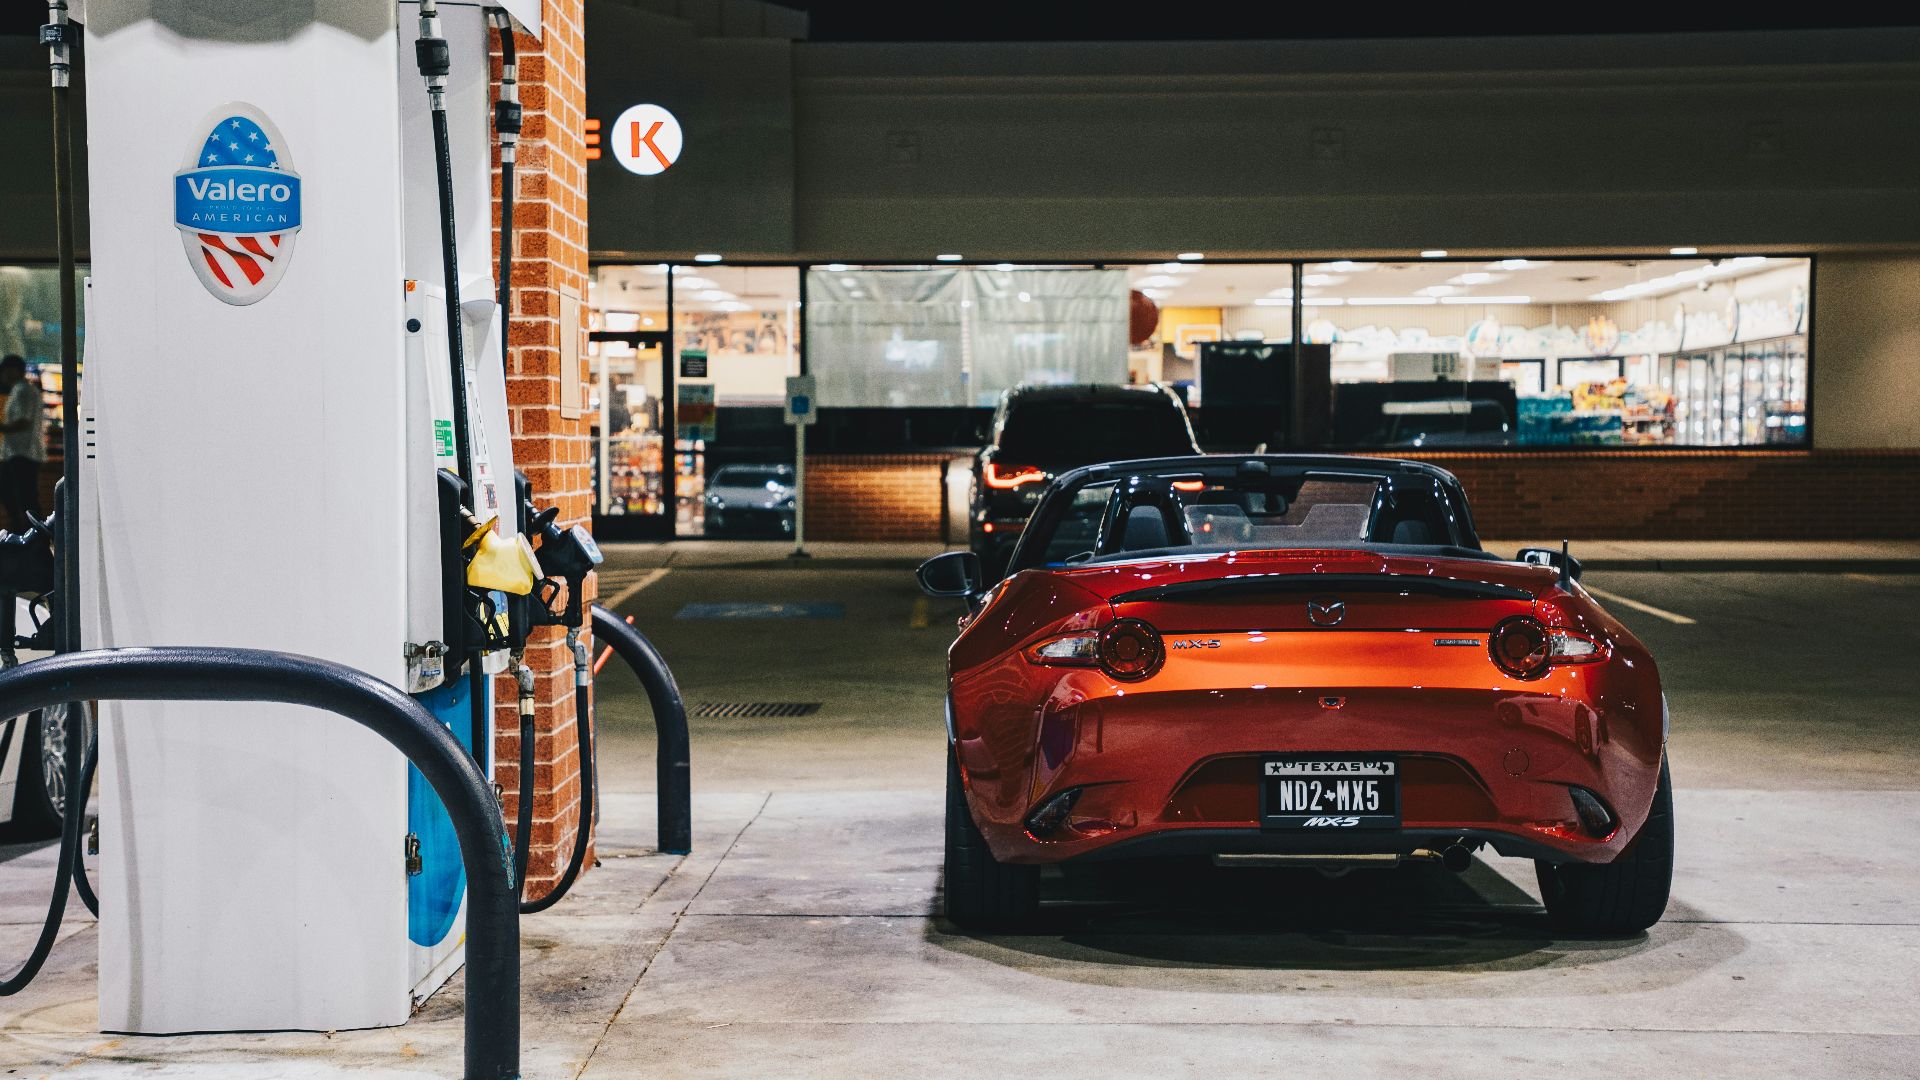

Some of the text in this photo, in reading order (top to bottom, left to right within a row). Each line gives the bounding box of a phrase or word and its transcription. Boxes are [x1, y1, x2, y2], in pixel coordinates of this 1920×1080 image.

[630, 121, 672, 170] K
[186, 177, 291, 202] Valero
[192, 212, 288, 223] AMERICAN
[1172, 639, 1221, 650] MX-5
[1298, 762, 1361, 772] TEXAS
[1302, 816, 1361, 827] MX-5
